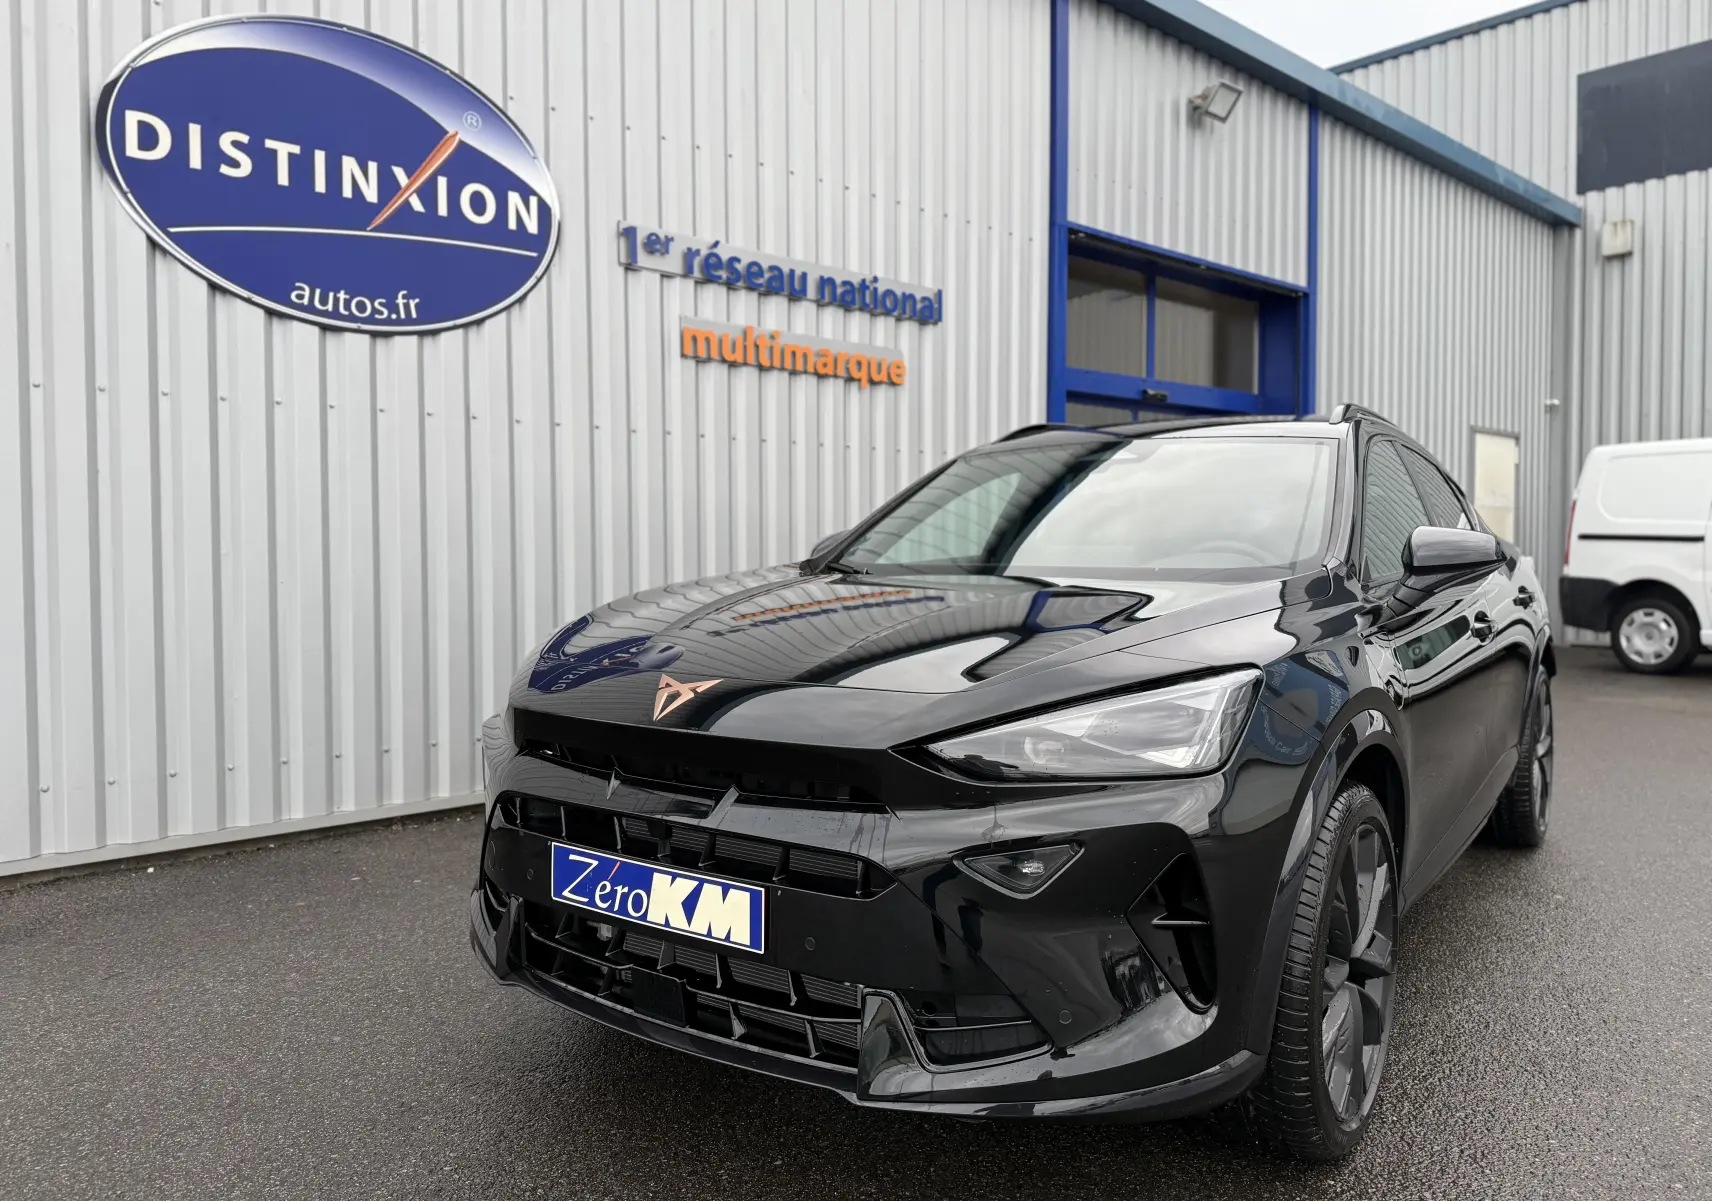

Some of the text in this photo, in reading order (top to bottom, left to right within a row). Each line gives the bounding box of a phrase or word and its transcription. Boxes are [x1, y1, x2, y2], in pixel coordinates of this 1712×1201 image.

[124, 109, 539, 235] DISTINXION
[290, 281, 421, 320] autos.fr
[622, 226, 943, 323] 1er réseau national
[682, 326, 906, 389] multimarque
